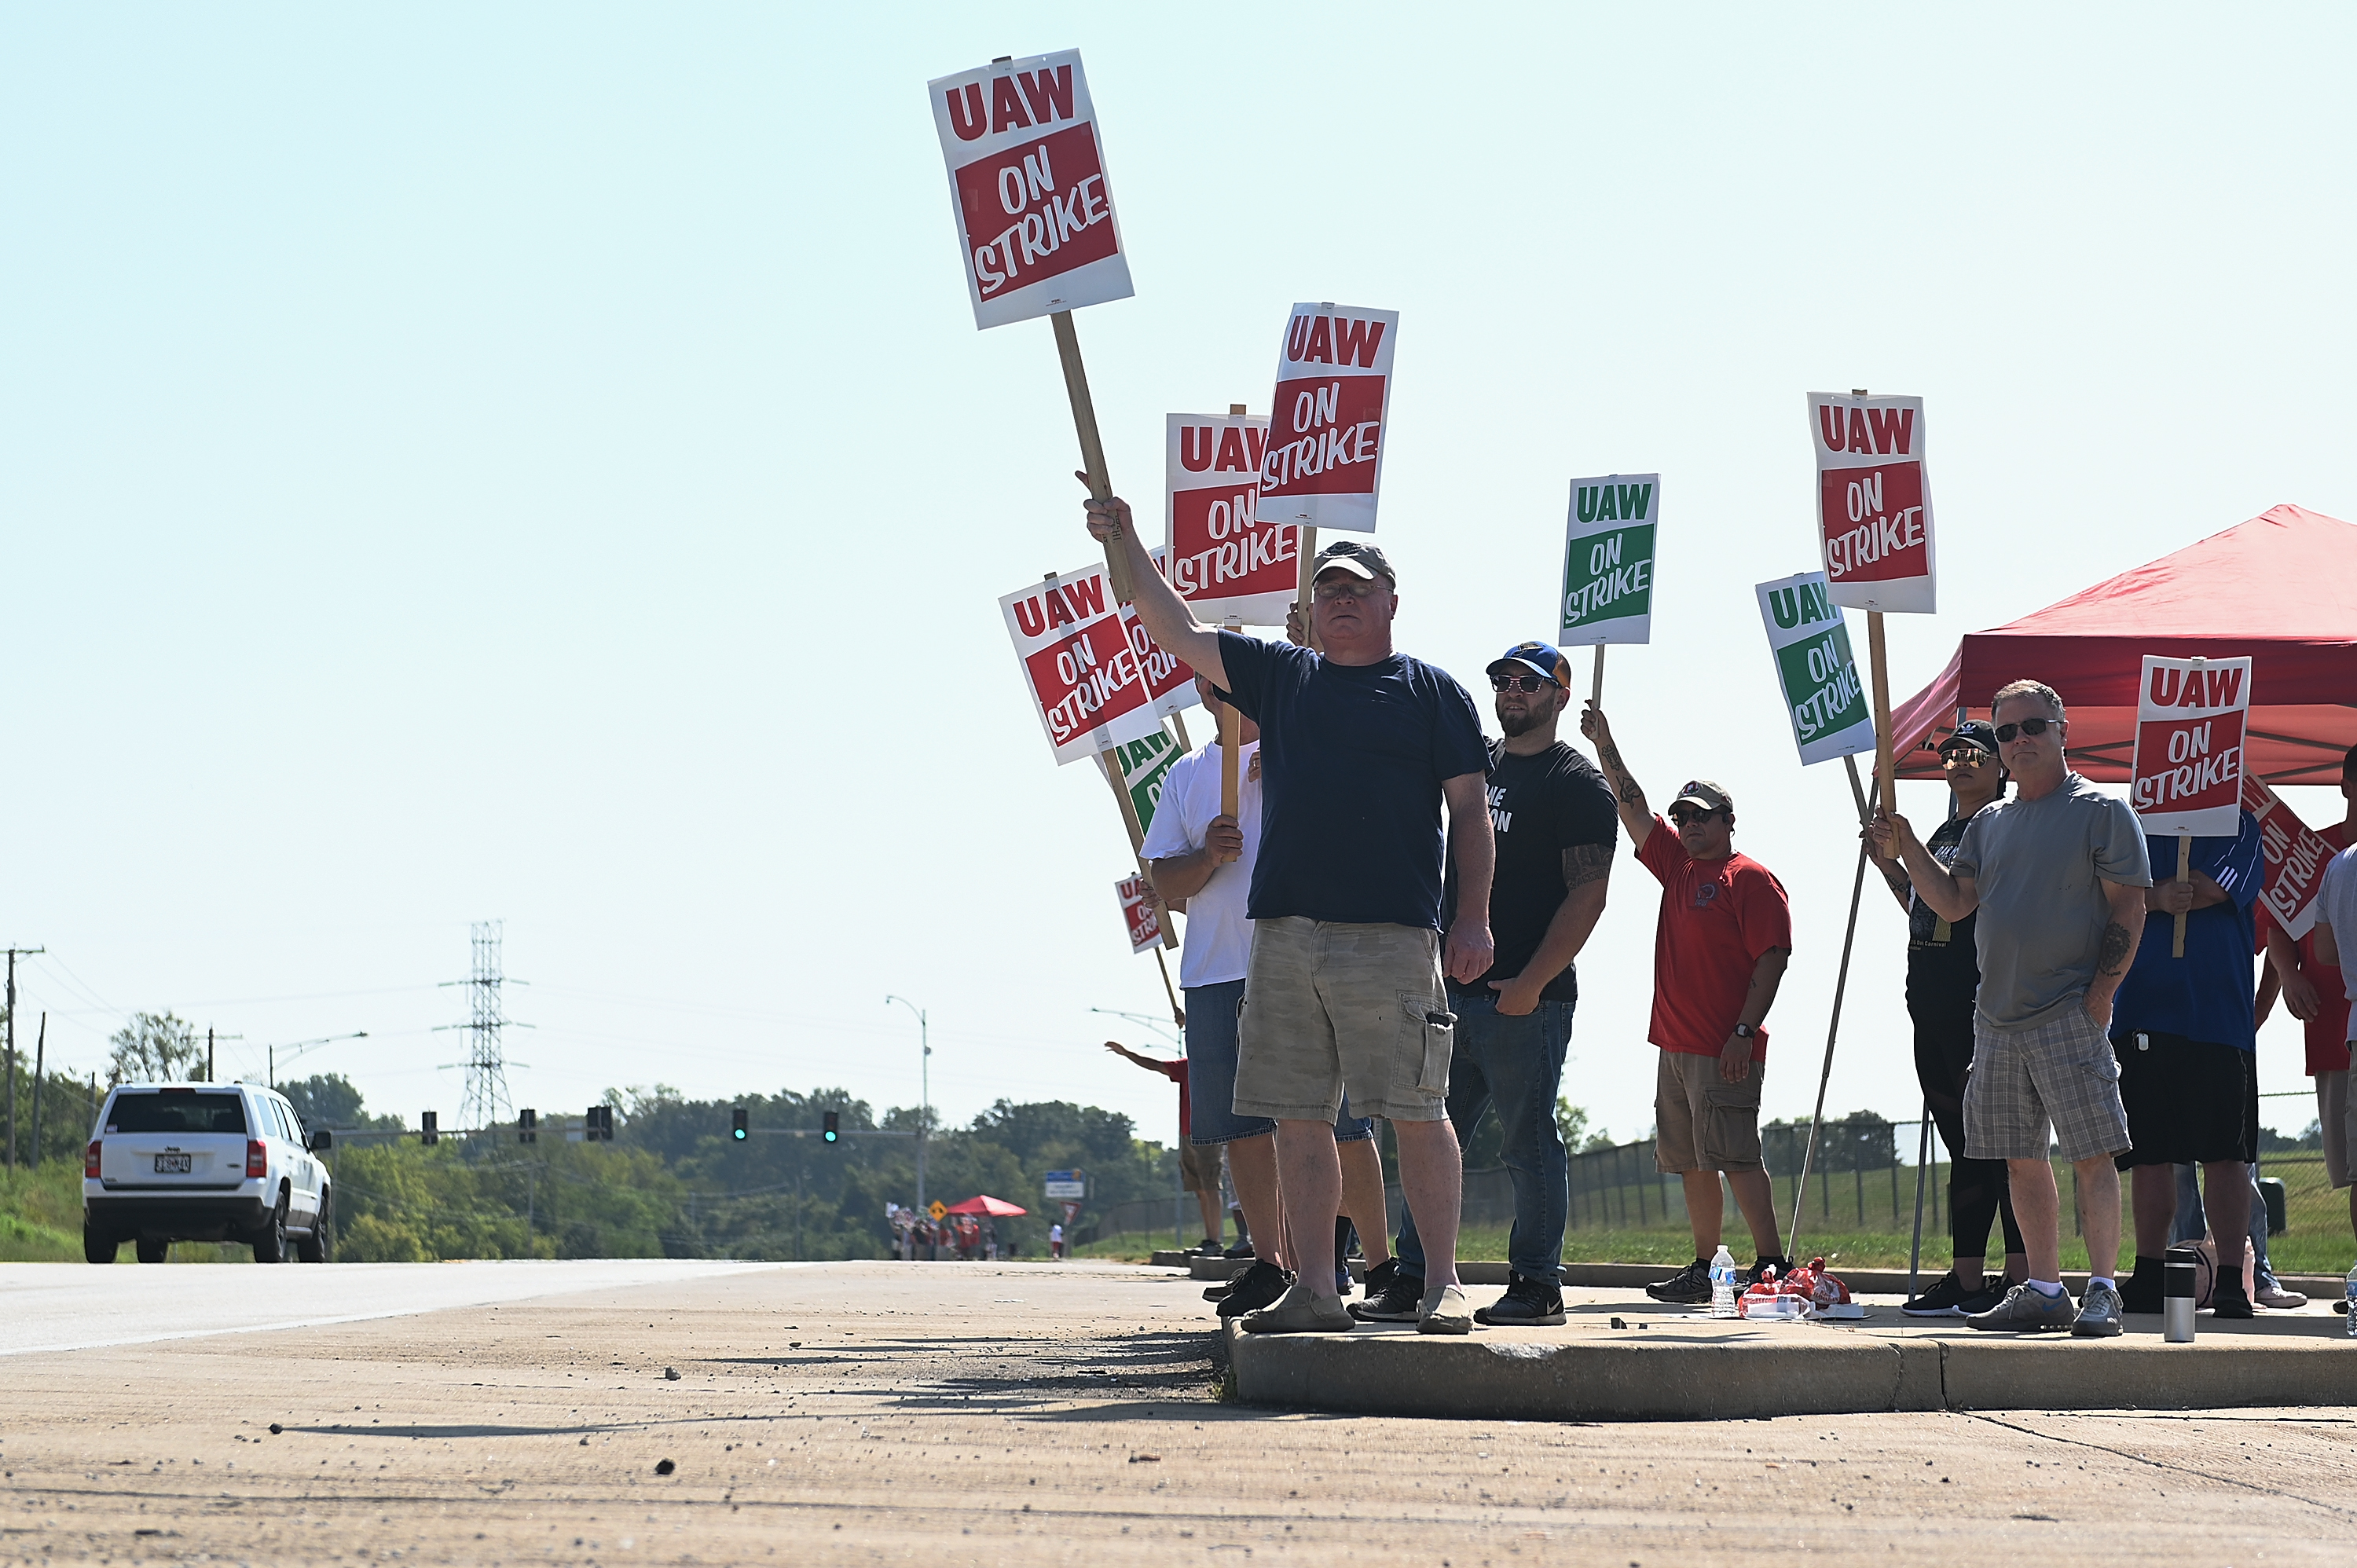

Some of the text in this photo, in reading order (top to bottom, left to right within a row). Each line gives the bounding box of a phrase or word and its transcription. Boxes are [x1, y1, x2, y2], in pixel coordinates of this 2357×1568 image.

[945, 64, 1074, 142] UAW
[998, 145, 1055, 214] ON
[974, 173, 1109, 294] STRIKE
[1287, 315, 1386, 368] UAW
[1293, 382, 1340, 434] ON
[1819, 405, 1915, 455] UAW
[1262, 421, 1380, 492] STRIKE
[1208, 489, 1255, 540] ON
[1577, 483, 1652, 523] UAW
[1846, 471, 1884, 522] ON
[1175, 524, 1296, 595] STRIKE
[1589, 533, 1623, 575] ON
[1827, 505, 1925, 578] STRIKE
[1013, 573, 1105, 637] UAW
[1565, 559, 1651, 625] STRIKE
[1057, 633, 1097, 685] ON
[1132, 624, 1157, 655] O
[1808, 634, 1839, 683] ON
[1047, 648, 1138, 742] STRIKE
[1794, 660, 1860, 740] STRIKE
[2150, 667, 2244, 708] UAW
[2168, 721, 2211, 764] ON
[2134, 746, 2239, 811] STRIKE
[2262, 818, 2291, 864] ON
[2269, 826, 2325, 918] STRIKE
